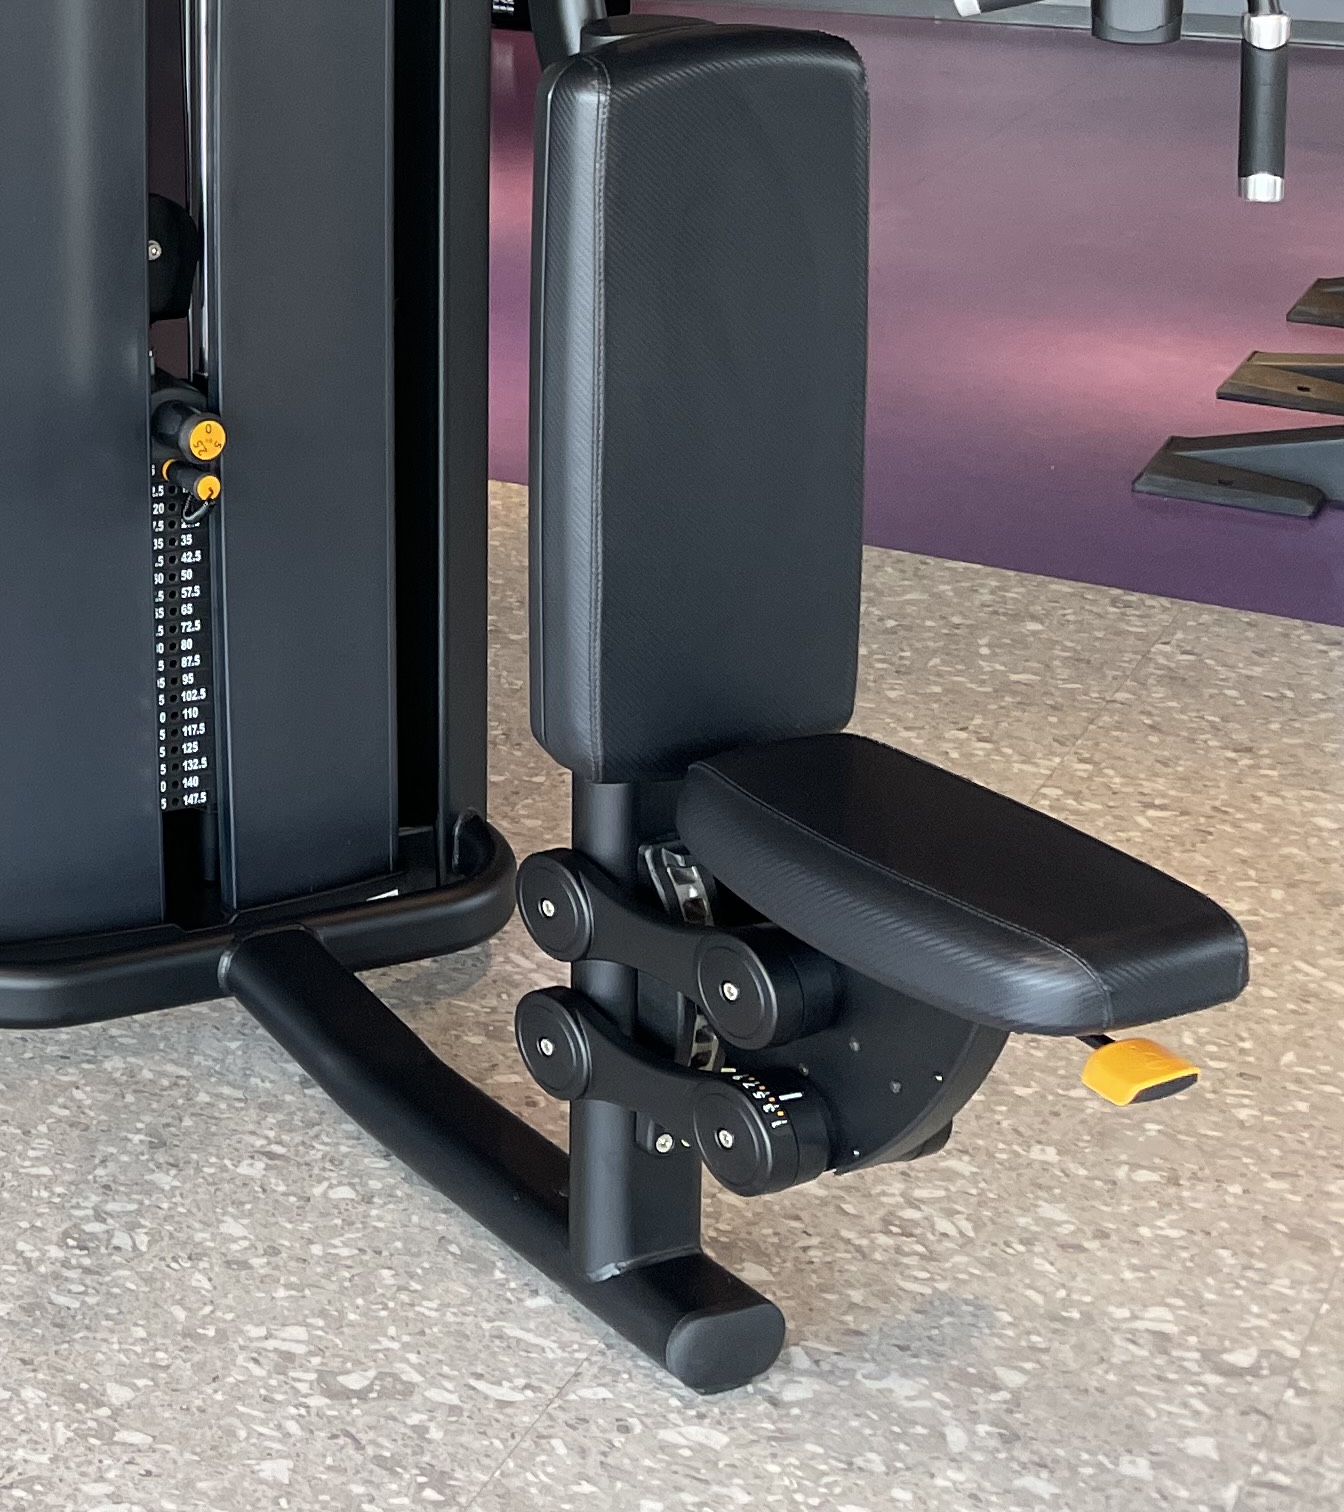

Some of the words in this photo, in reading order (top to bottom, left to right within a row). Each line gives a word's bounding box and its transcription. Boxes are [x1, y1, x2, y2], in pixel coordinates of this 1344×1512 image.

[205, 424, 212, 434] 0
[181, 534, 192, 546] 35
[181, 550, 201, 563] 42.5
[181, 569, 192, 581] 50
[181, 585, 200, 599] 57.5
[181, 603, 192, 615] 65
[181, 620, 200, 633] 72.5
[181, 638, 192, 650] 80
[181, 654, 200, 668] 87.5
[182, 673, 194, 685] 95
[181, 688, 206, 702] 102.5
[182, 707, 199, 720] 110
[182, 723, 205, 737] 117.5
[182, 741, 199, 754] 125
[182, 757, 207, 771] 132.5
[182, 776, 199, 788] 140
[183, 792, 207, 805] 147.5
